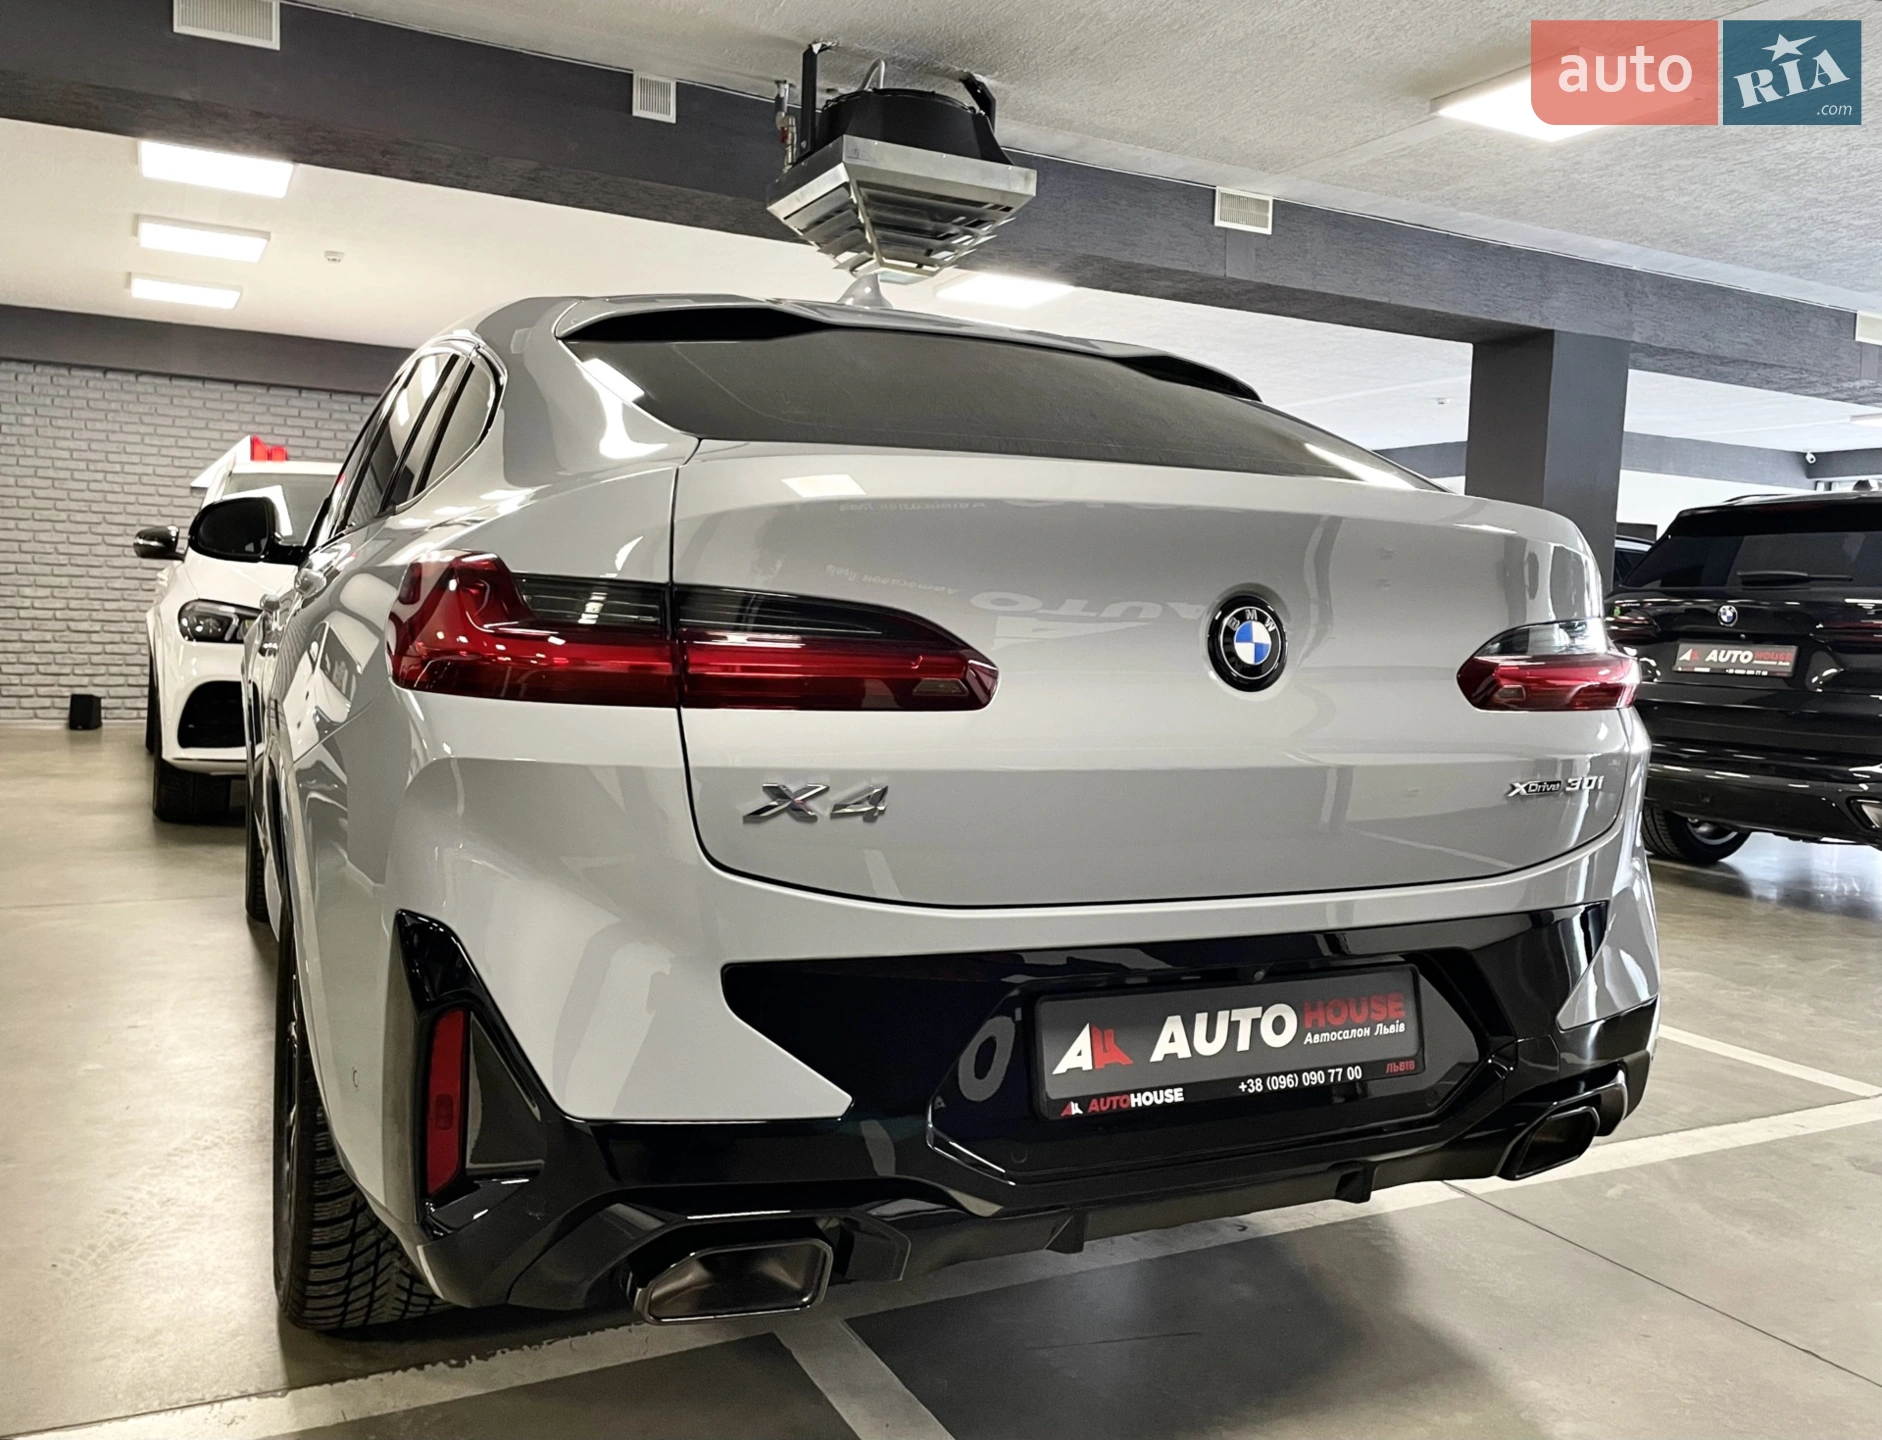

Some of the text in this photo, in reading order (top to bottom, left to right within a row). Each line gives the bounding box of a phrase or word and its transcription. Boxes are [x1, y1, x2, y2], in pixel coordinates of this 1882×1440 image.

[1226, 609, 1277, 632] BMW
[1704, 649, 1754, 664] AUTO
[743, 783, 889, 823] X4
[1150, 992, 1406, 1062] AUTO HOUSE
[1303, 1020, 1406, 1045] Автосалон Львів
[1238, 1065, 1363, 1094] +38 (096) 090 77 00
[1386, 1059, 1416, 1074] ЛЬВІВ
[1087, 1087, 1185, 1114] AUTOHOUSE
